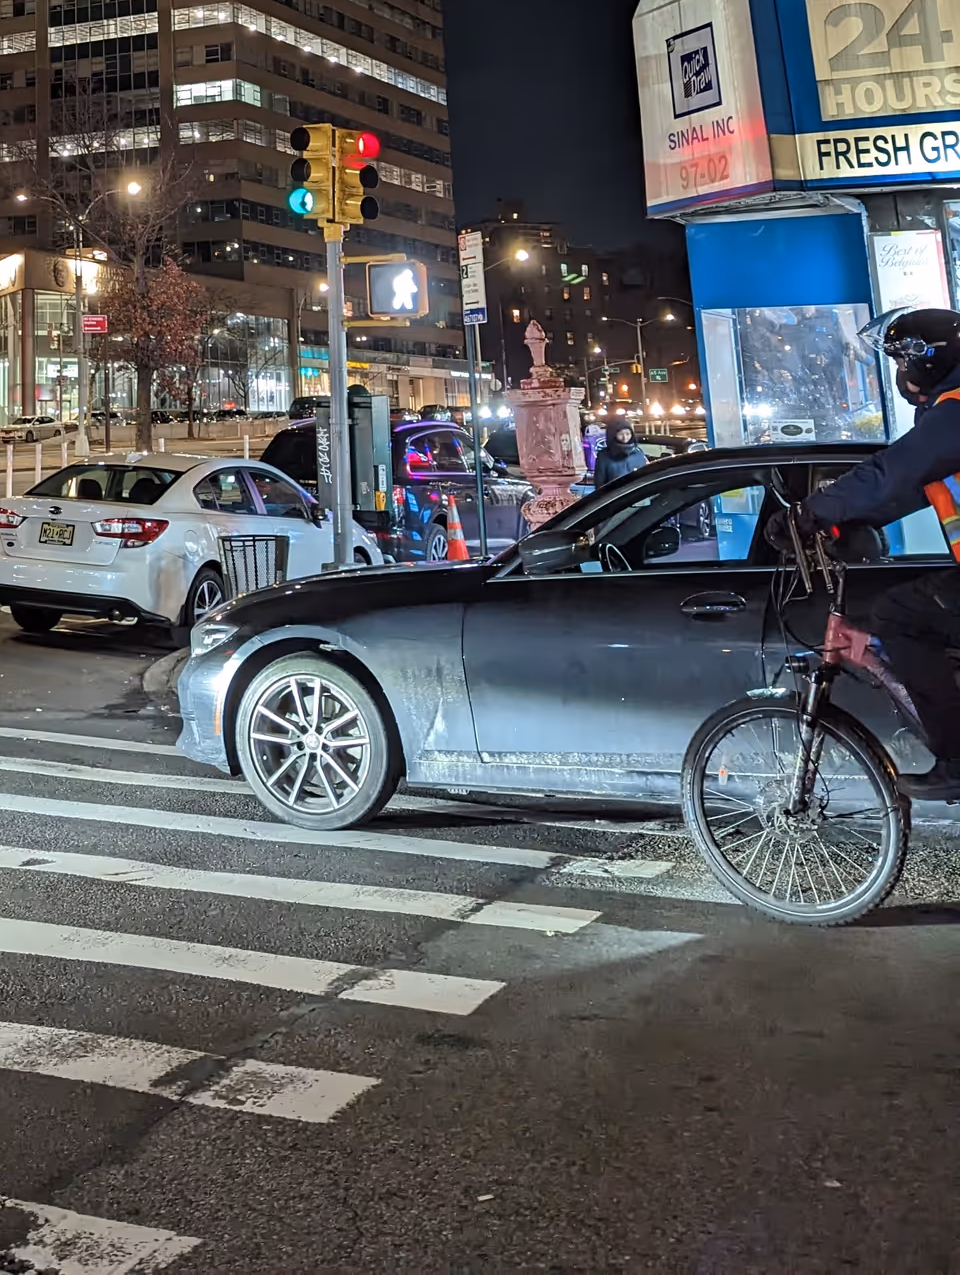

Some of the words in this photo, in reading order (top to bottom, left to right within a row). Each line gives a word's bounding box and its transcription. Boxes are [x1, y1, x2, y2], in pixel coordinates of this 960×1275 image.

[682, 47, 705, 83] Quick
[691, 66, 712, 98] Draw
[823, 72, 960, 116] HOURS
[668, 122, 709, 151] SINAL
[711, 115, 735, 140] INC
[816, 132, 912, 171] FRESH
[919, 129, 960, 164] GR
[679, 153, 730, 190] 97-02
[879, 242, 913, 257] Best
[462, 265, 468, 279] 2
